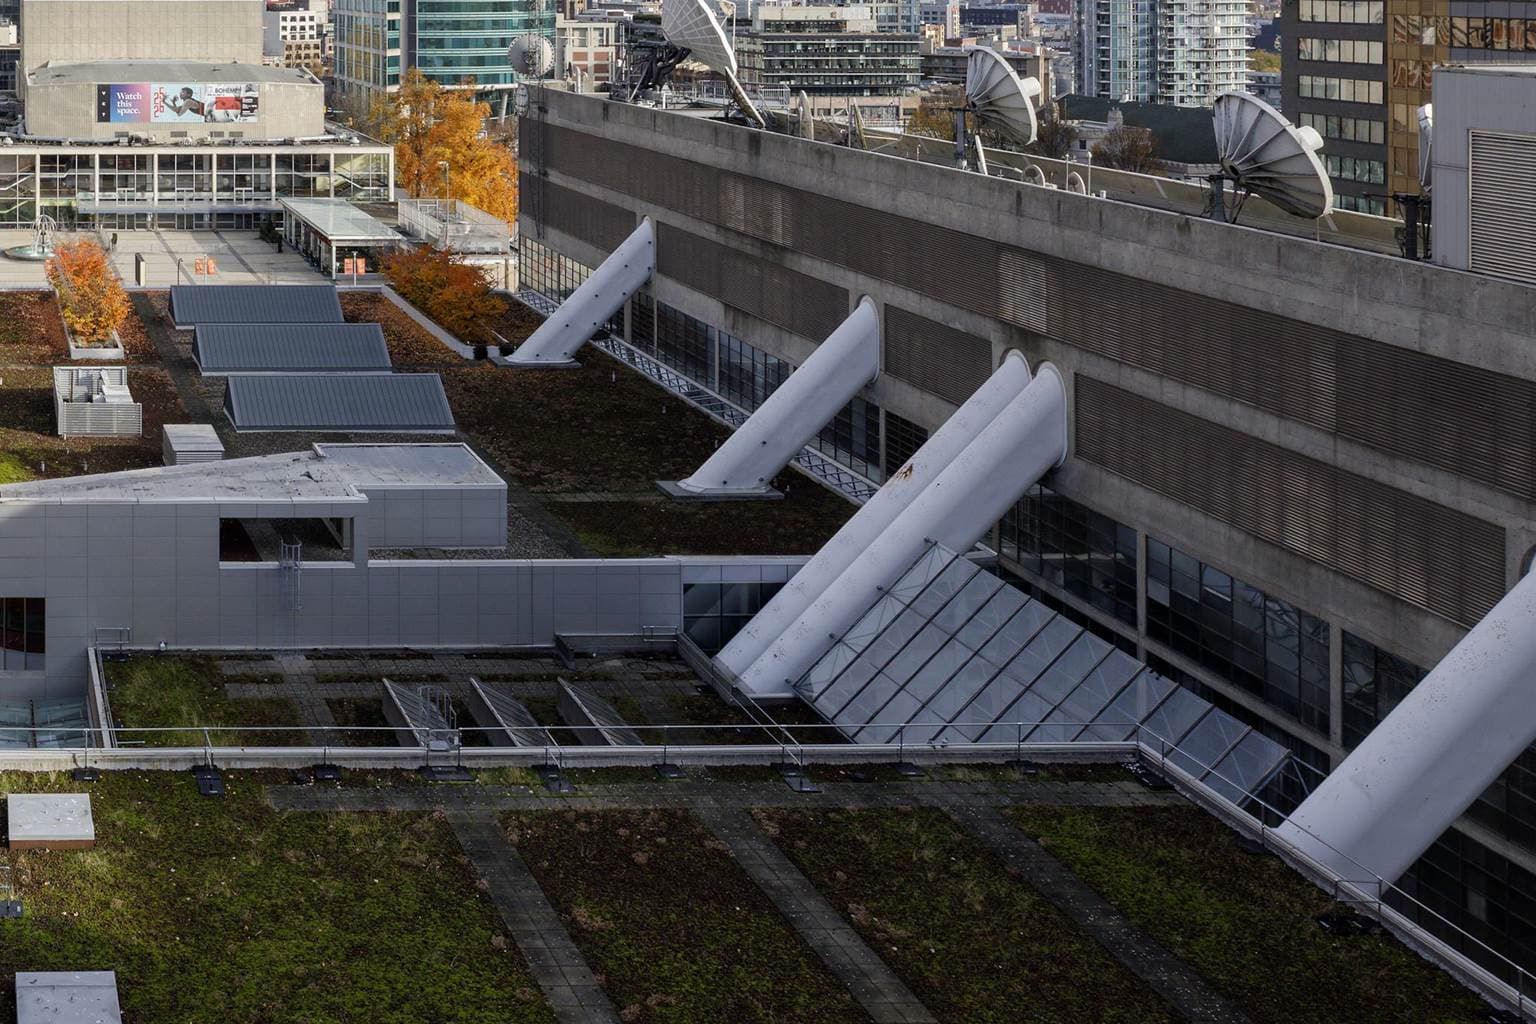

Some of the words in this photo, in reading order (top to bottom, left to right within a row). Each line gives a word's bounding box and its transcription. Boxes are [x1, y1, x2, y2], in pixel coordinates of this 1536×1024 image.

[116, 92, 142, 100] Watch
[117, 100, 132, 108] this
[117, 108, 140, 116] space.
